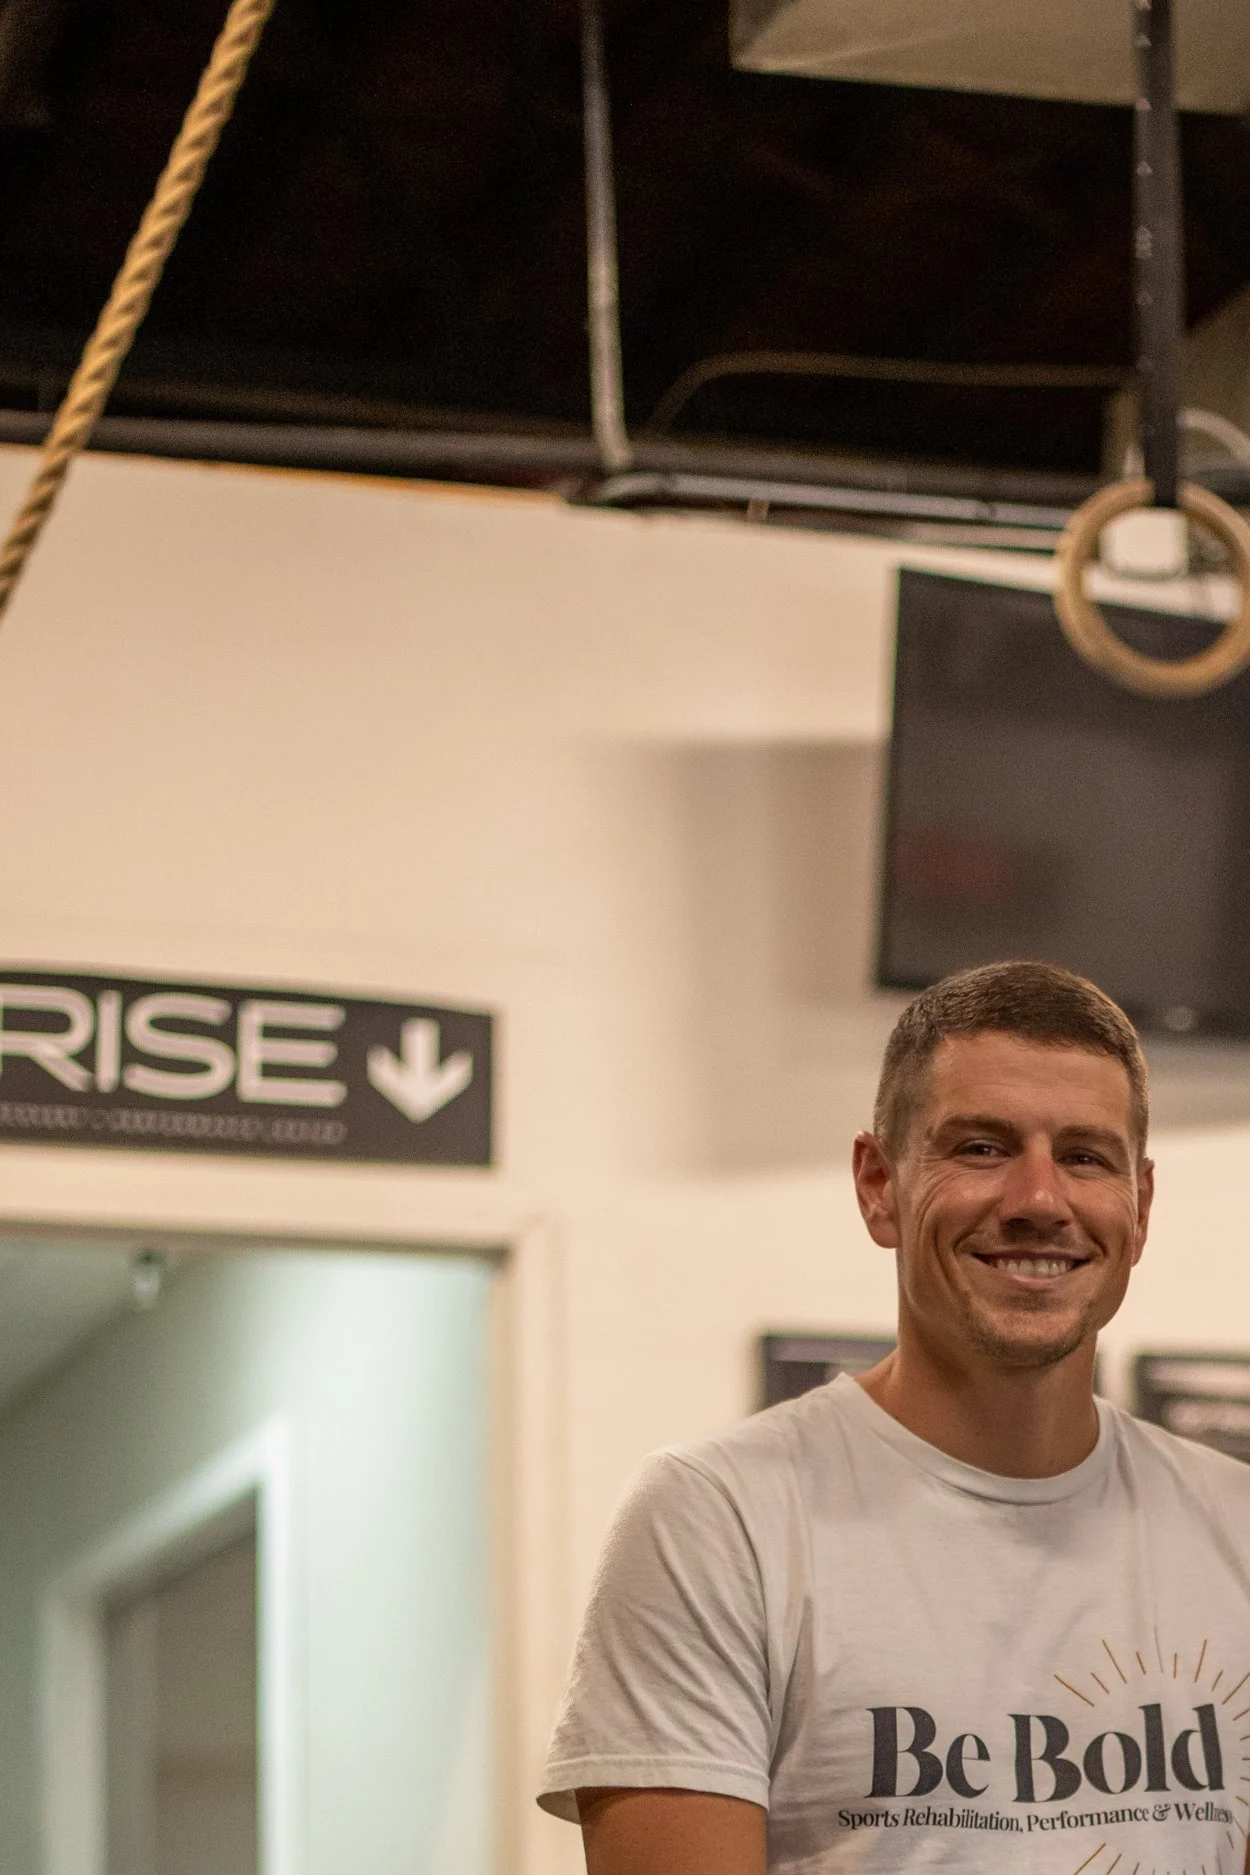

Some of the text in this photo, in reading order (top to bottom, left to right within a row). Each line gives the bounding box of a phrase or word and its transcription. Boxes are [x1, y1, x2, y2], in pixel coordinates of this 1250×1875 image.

[0, 983, 347, 1107] RISE
[865, 1703, 1225, 1804] Be Bold
[838, 1809, 900, 1831] Sports
[902, 1806, 1024, 1833] Rehabilitation,
[1026, 1807, 1149, 1833] Performance
[1152, 1802, 1171, 1823] &
